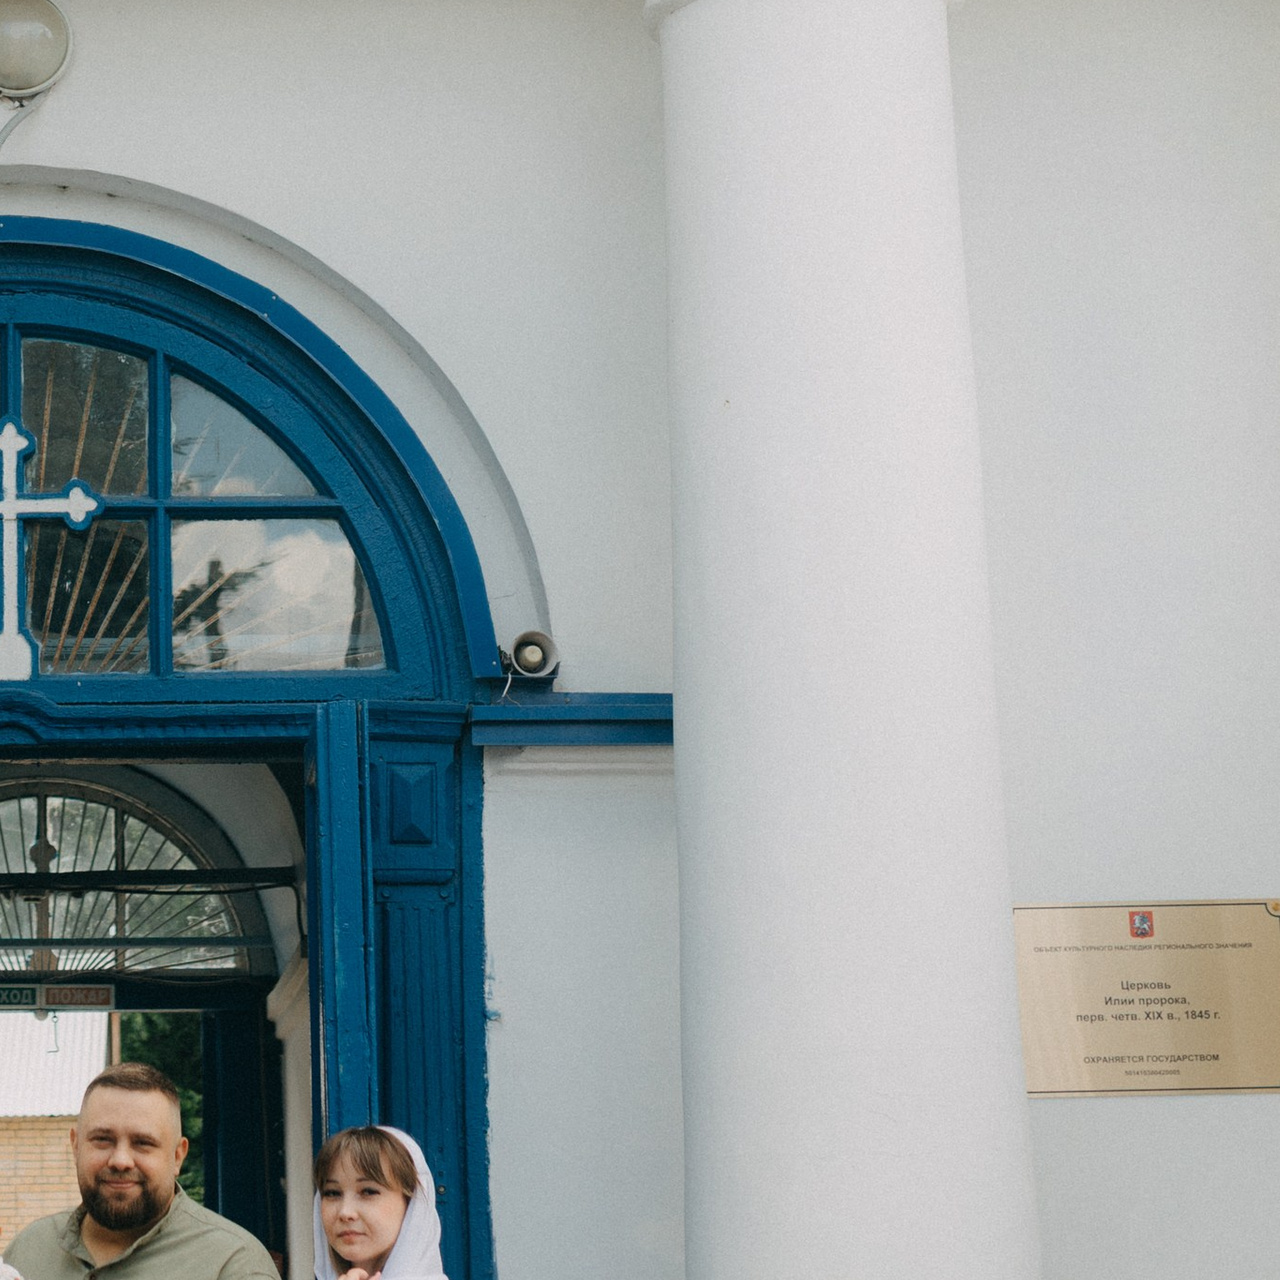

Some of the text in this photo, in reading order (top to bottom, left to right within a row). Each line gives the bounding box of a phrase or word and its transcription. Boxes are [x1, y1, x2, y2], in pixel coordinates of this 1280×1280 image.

[1063, 945, 1113, 953] КУЛЬТУРНОГО
[1114, 944, 1152, 952] НАСЛЕДИЯ
[1153, 943, 1214, 951] РЕГИОНАЛЬНОГО
[1215, 942, 1253, 950] ЗНАЧЕНИЯ
[1120, 980, 1172, 991] Церковь
[48, 989, 106, 1003] ПОЖАР
[1104, 996, 1191, 1007] Илии пророка,
[1076, 1014, 1108, 1024] перв.
[1111, 1013, 1141, 1021] четв.
[1144, 1011, 1163, 1021] XIX
[1184, 1010, 1211, 1020] 1845
[1213, 1011, 1221, 1020] г.
[1083, 1054, 1220, 1064] ОХРАНЯЕТСЯ ГОСУДАРСТВОМ
